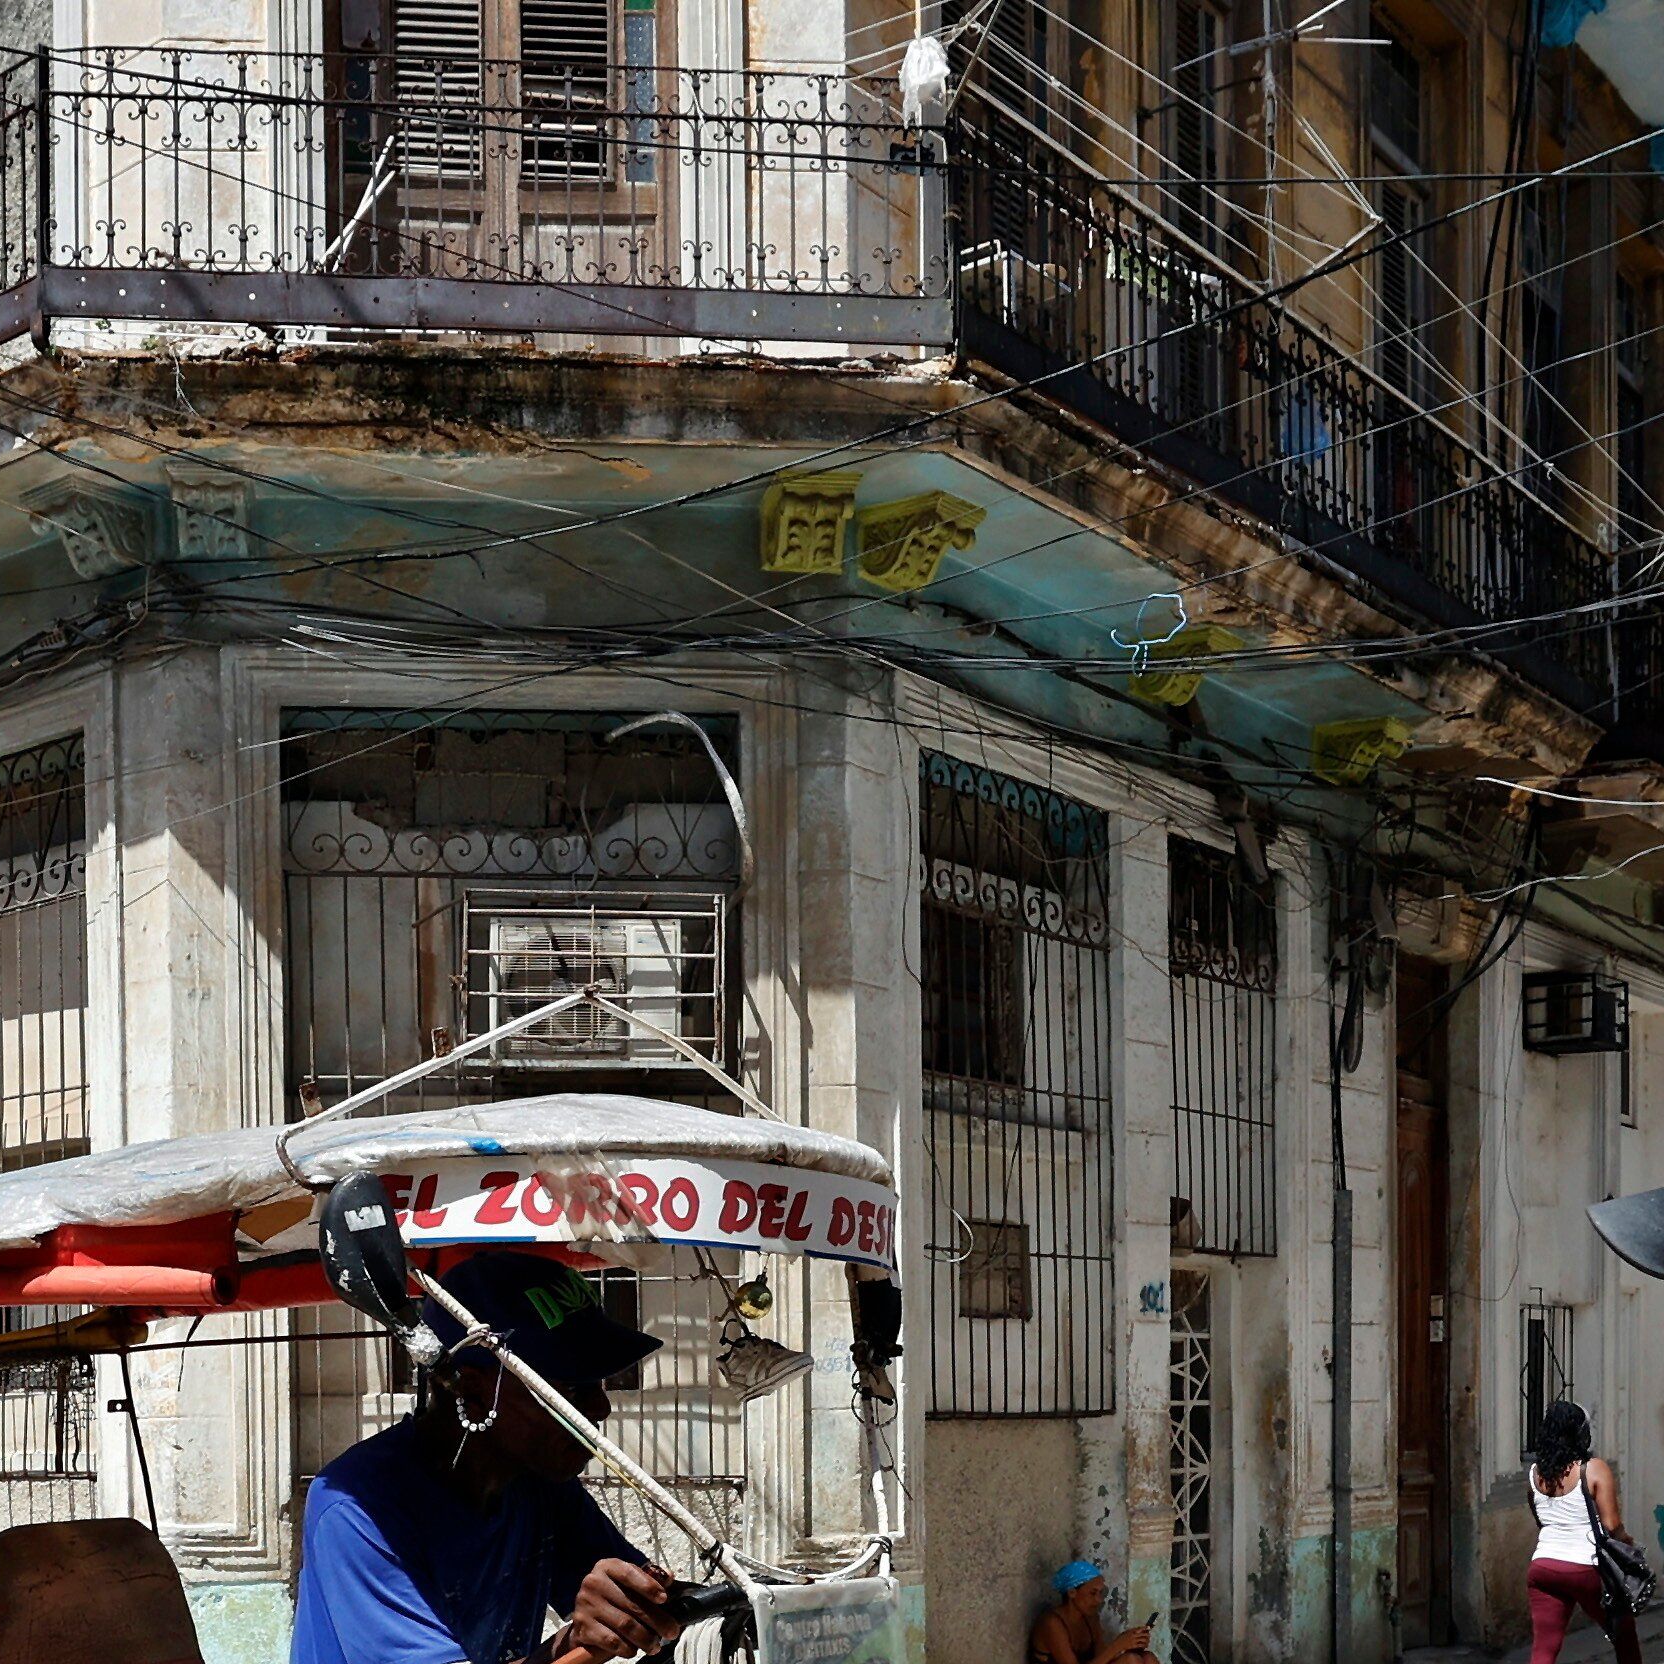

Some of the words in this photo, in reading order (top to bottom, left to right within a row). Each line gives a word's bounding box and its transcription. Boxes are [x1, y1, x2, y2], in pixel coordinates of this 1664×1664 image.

[379, 1173, 449, 1230] EL
[474, 1170, 700, 1232] ZORRO
[718, 1179, 813, 1242] DEL
[822, 1612, 872, 1637] Habana
